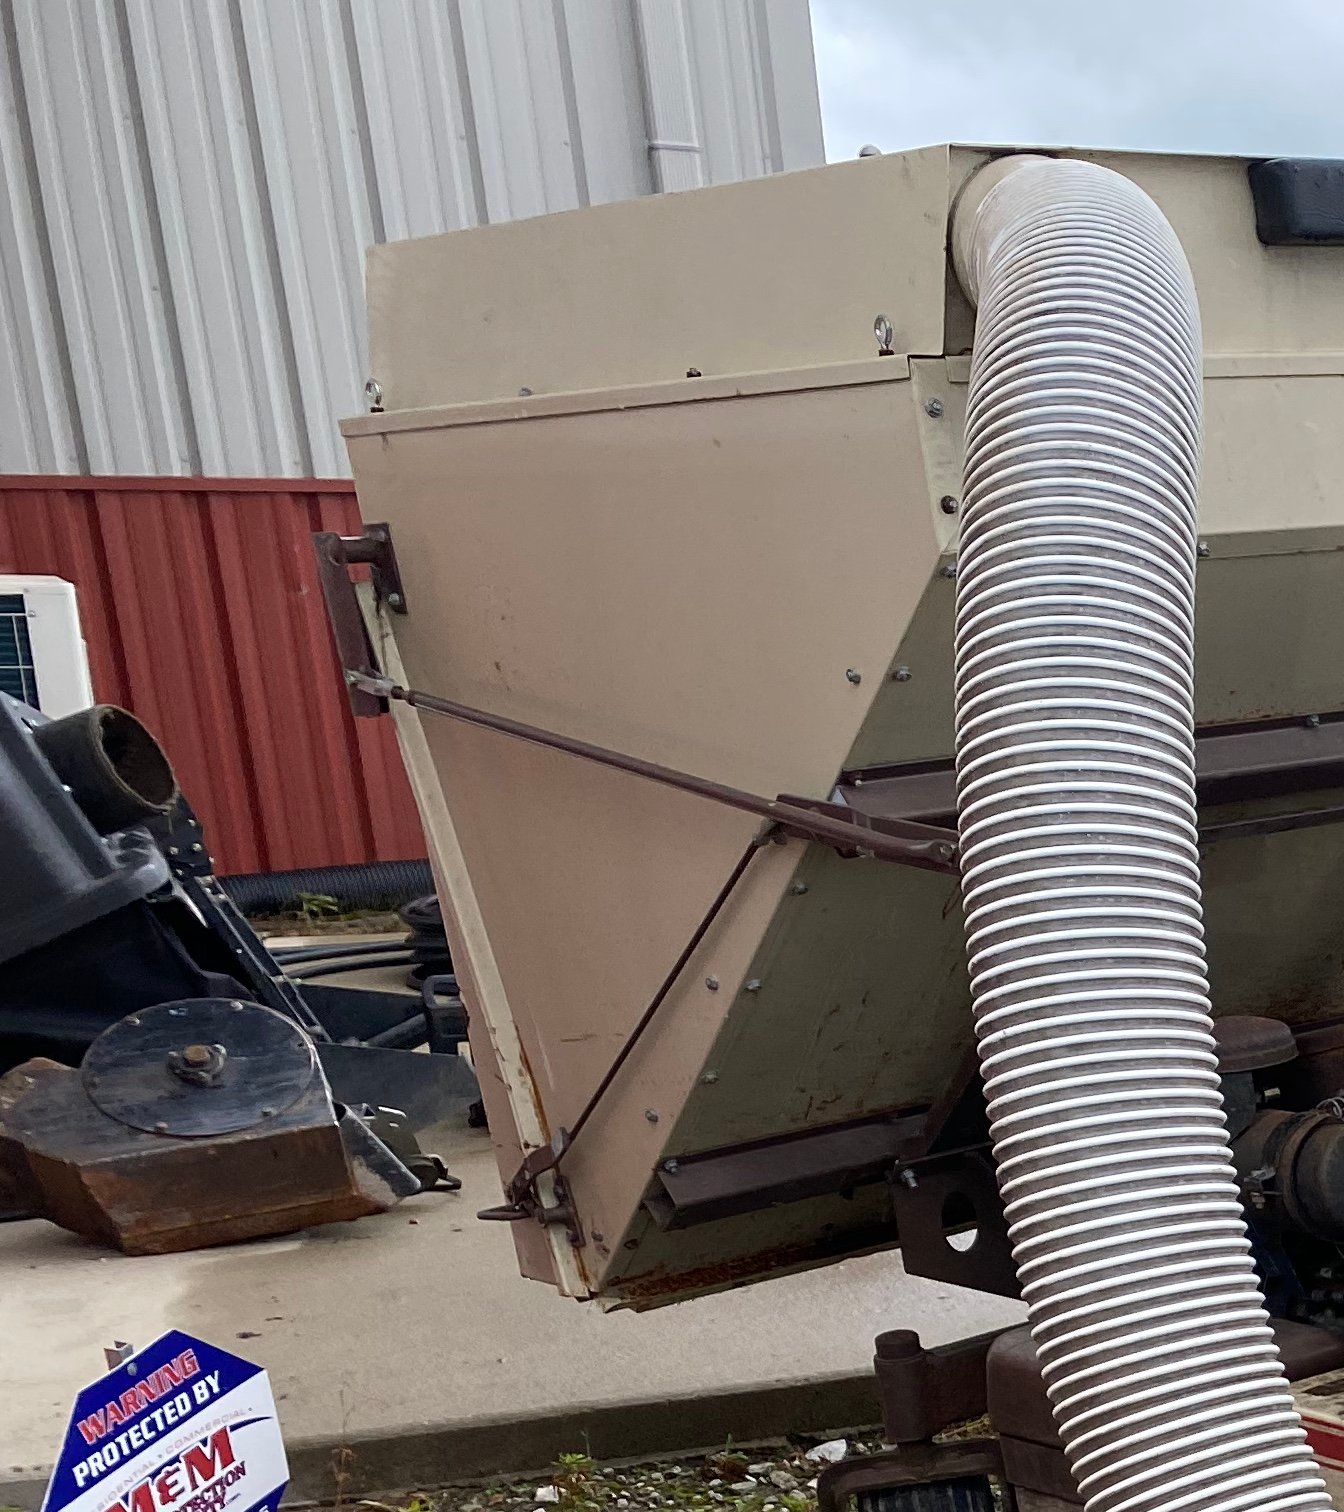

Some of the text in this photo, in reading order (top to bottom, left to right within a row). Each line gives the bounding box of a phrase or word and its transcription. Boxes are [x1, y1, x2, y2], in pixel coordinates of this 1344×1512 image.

[72, 1370, 221, 1488] PROTECTED BY
[77, 1348, 201, 1446] WARNING
